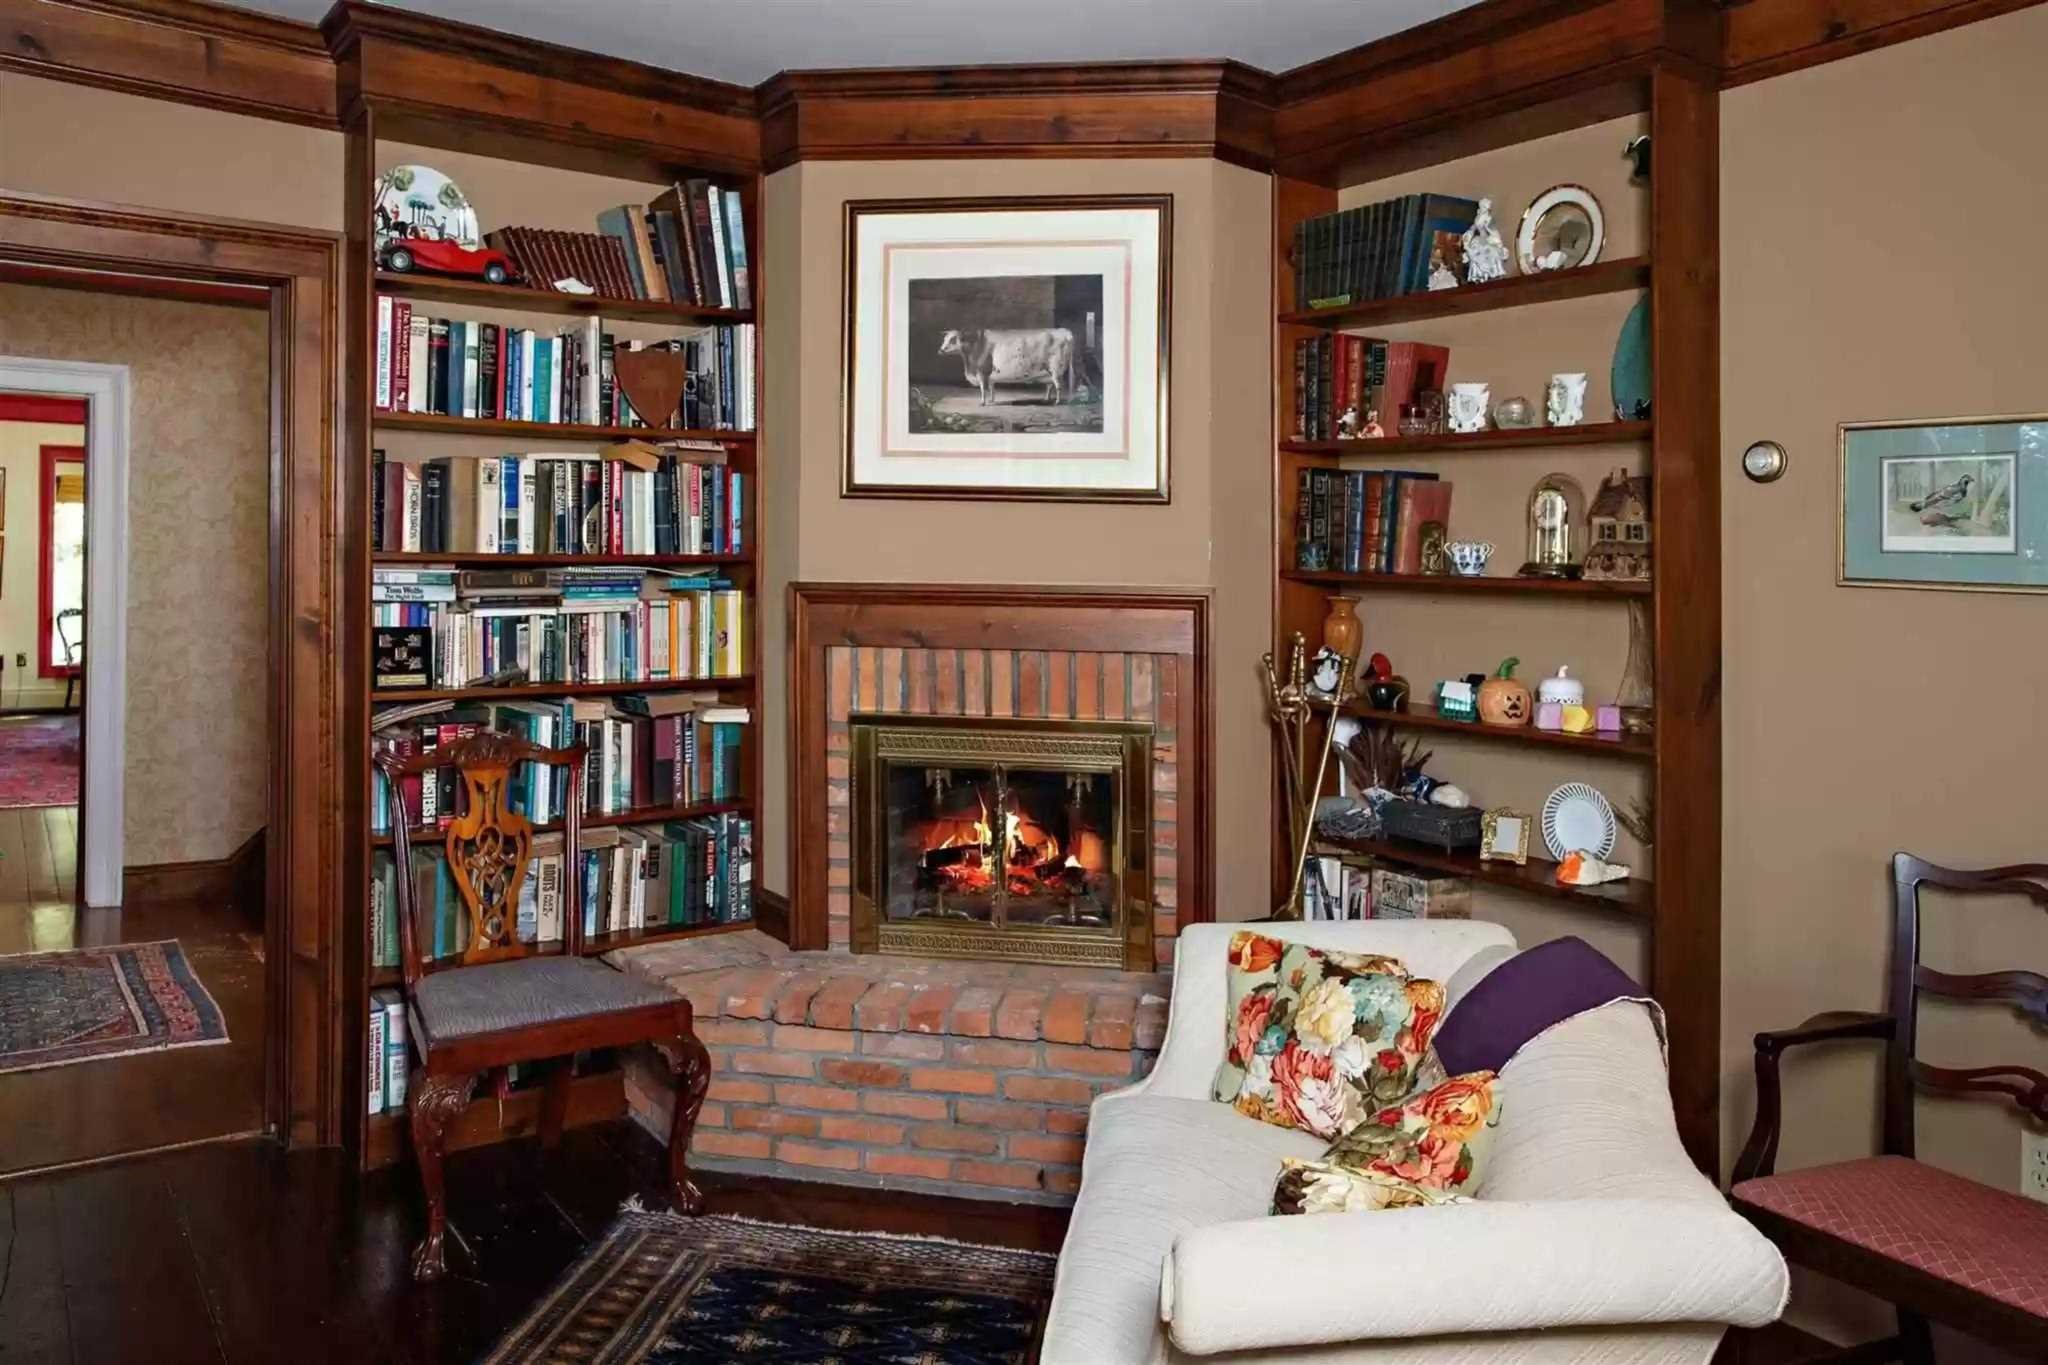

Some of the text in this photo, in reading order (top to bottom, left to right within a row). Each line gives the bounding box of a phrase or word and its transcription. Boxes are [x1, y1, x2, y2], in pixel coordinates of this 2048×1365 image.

[402, 309, 411, 325] The
[400, 325, 411, 348] Victory
[410, 484, 418, 514] THORN
[384, 586, 402, 594] Tom
[542, 864, 557, 892] ROOTS
